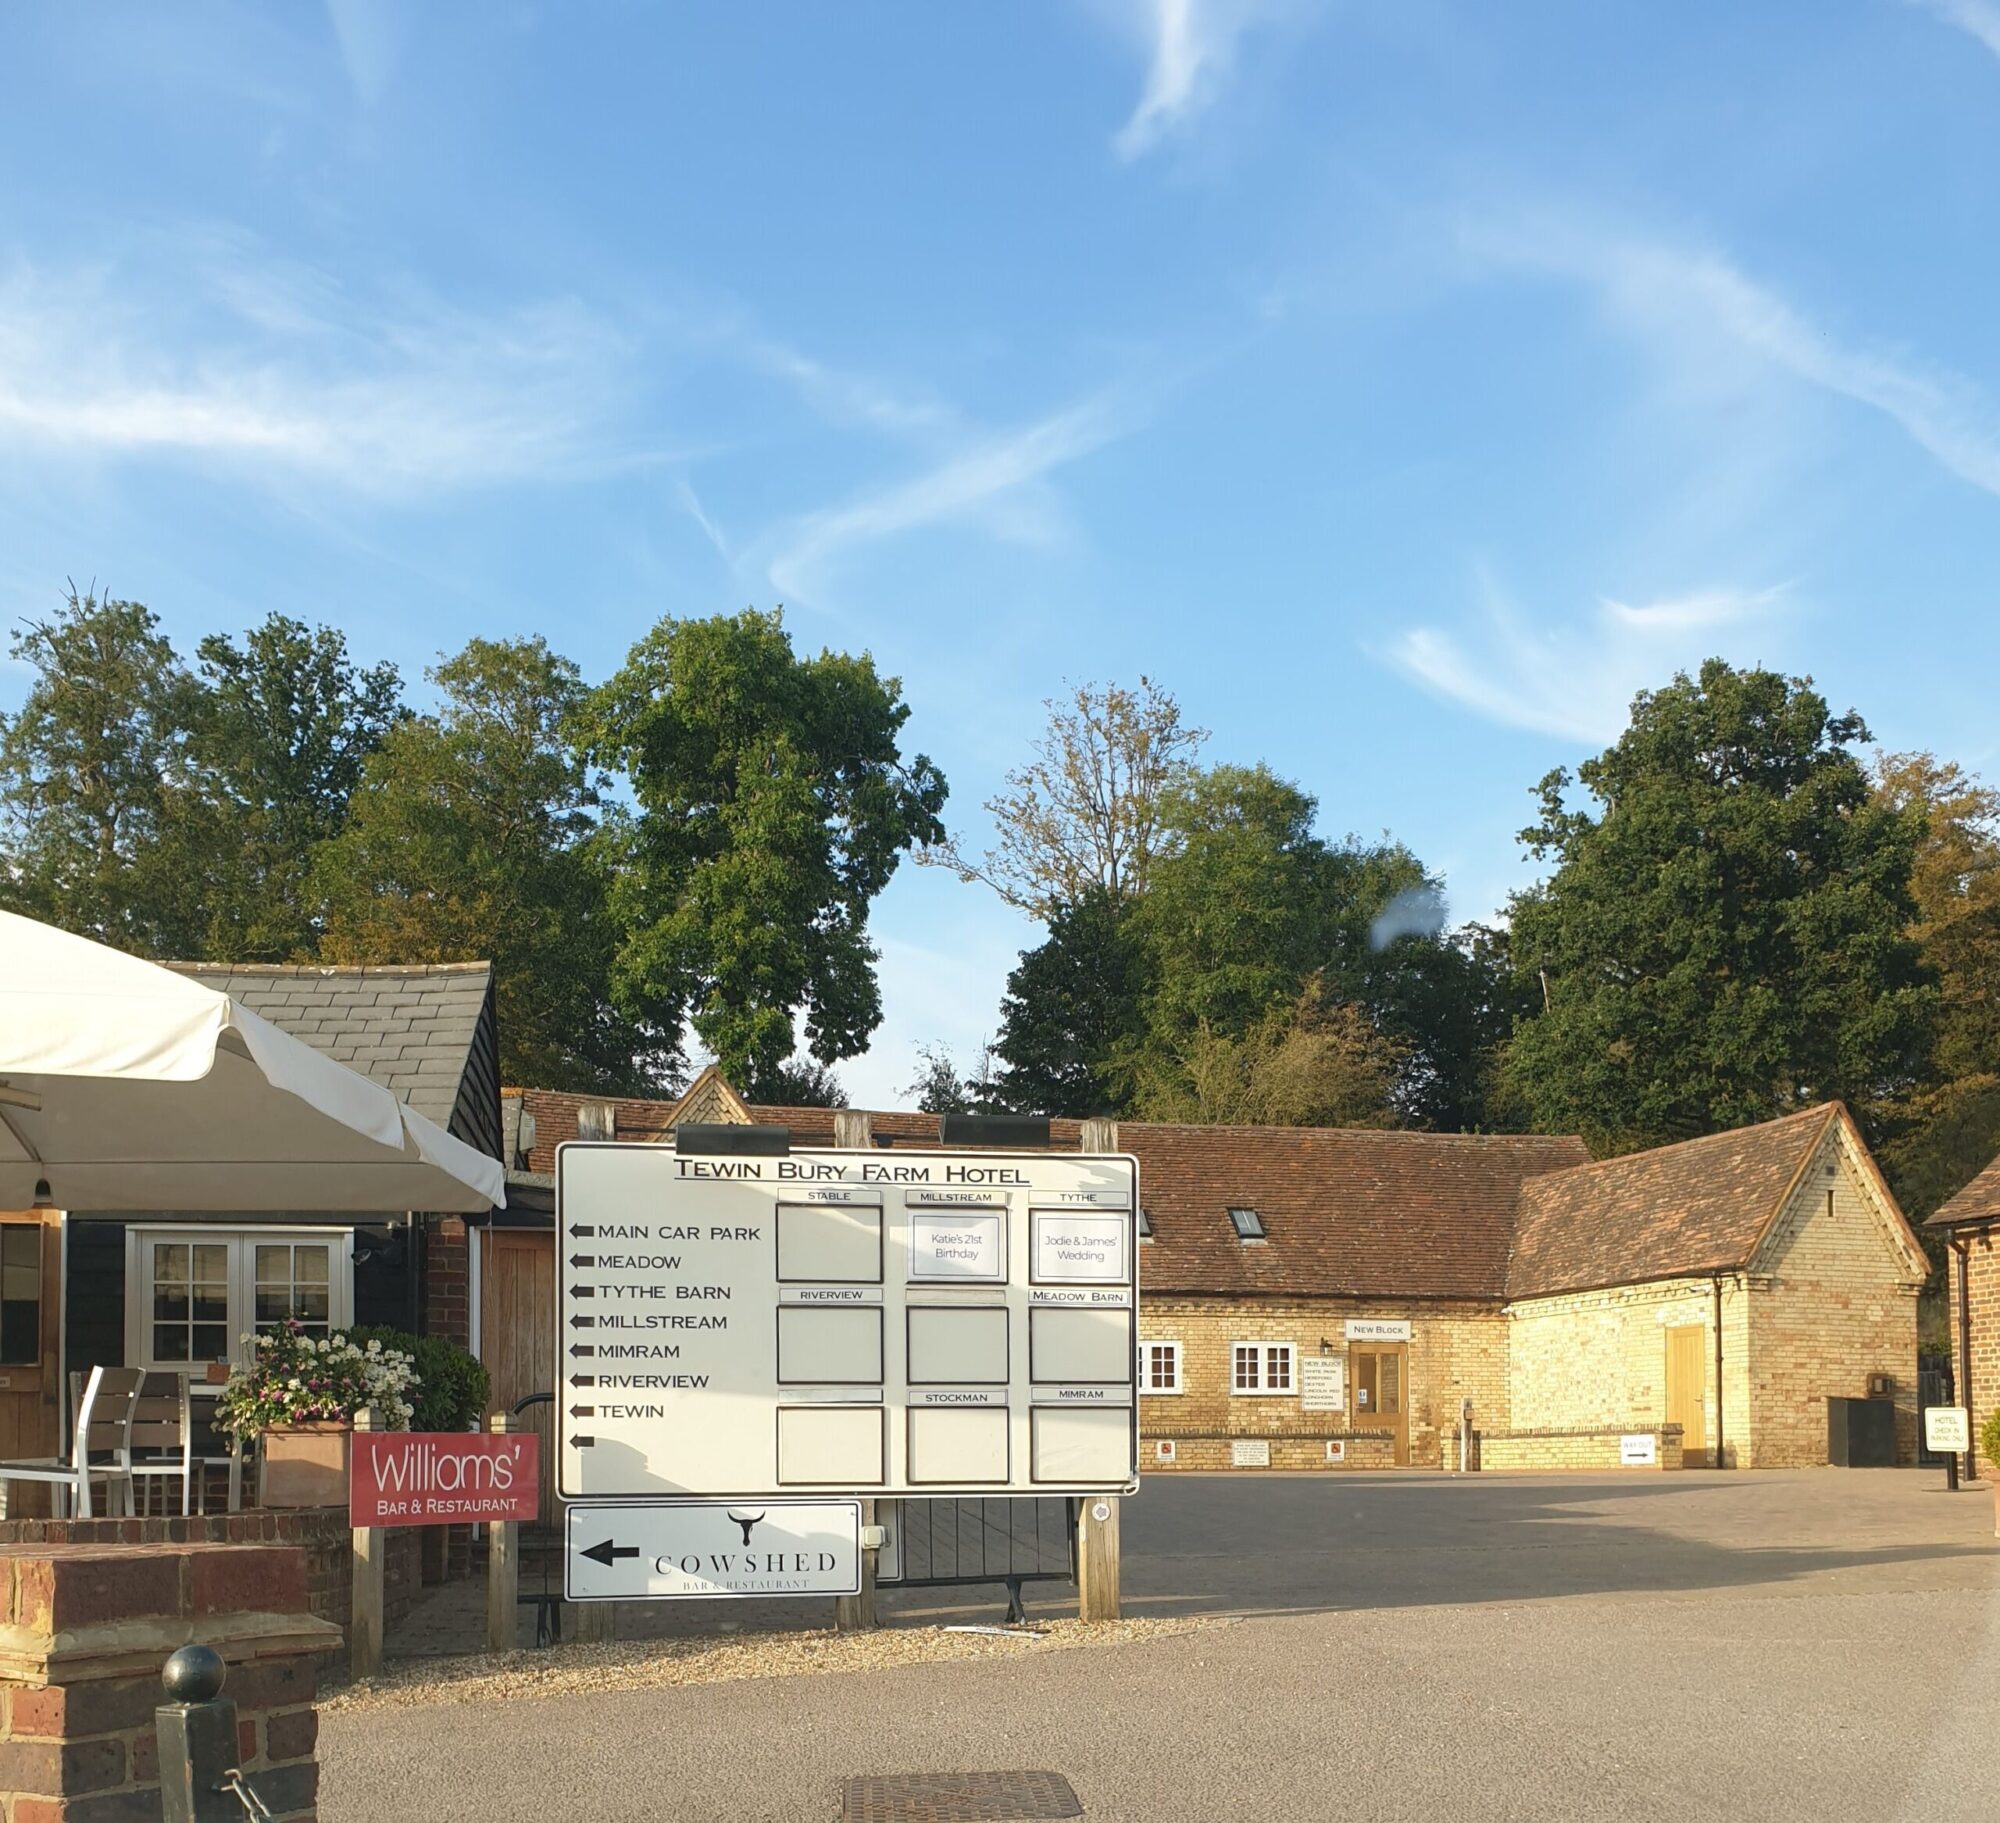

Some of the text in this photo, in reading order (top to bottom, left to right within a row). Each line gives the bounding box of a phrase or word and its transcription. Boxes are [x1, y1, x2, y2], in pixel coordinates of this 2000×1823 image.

[674, 1158, 1030, 1184] TEWIN BURY FARM HOTEL
[808, 1191, 851, 1201] STABLE
[920, 1192, 992, 1202] MILLSTREAM
[1060, 1193, 1097, 1202] TYTHE
[598, 1225, 761, 1241] MAIN CAR PARK
[931, 1233, 983, 1245] Katie's 21st
[1045, 1235, 1072, 1247] Jodie
[1073, 1236, 1081, 1247] &
[935, 1247, 980, 1260] Birthday
[1057, 1249, 1105, 1263] Wedding
[598, 1255, 682, 1269] MEADOW
[598, 1285, 731, 1300] TYTHE BARN
[800, 1290, 863, 1300] RIVERVIEW
[1033, 1290, 1124, 1302] MEADOW BARN
[598, 1315, 728, 1329] MILLSTREAM
[598, 1345, 680, 1359] MIMRAM
[598, 1375, 710, 1389] RIVERVIEW
[925, 1393, 988, 1403] STOCKMAN
[1059, 1390, 1104, 1399] MIMRAM
[598, 1405, 664, 1418] TEWIN
[371, 1442, 521, 1493] Williams'
[377, 1498, 518, 1516] BAR & RESTAURANT
[655, 1552, 837, 1575] COWSHED
[682, 1578, 810, 1592] BAR & RESTAURANT
